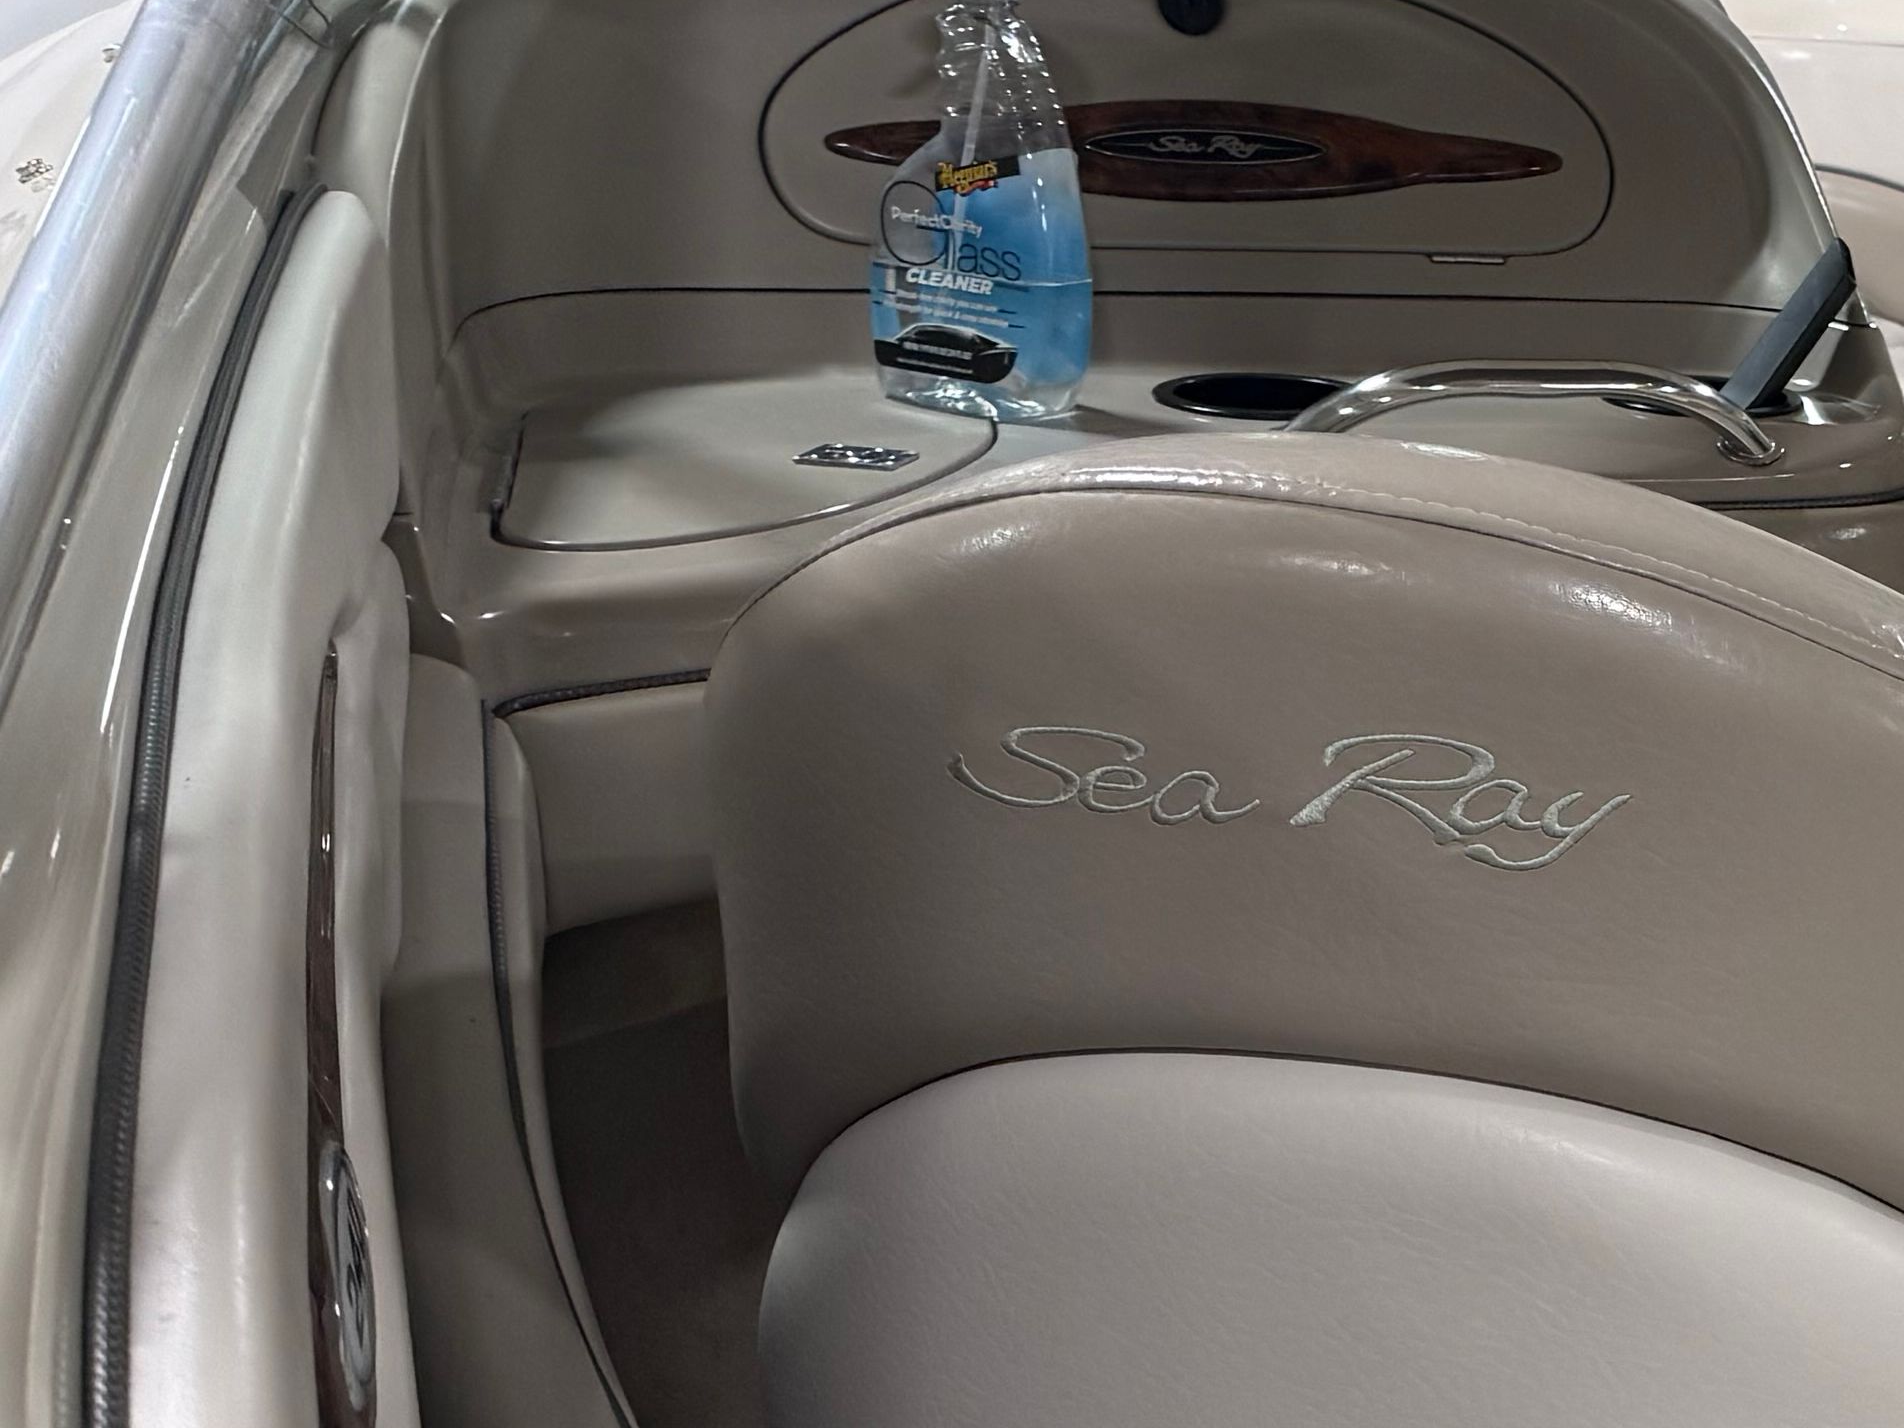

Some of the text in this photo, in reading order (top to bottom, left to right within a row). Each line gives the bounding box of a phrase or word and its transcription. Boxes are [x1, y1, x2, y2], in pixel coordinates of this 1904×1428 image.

[905, 267, 995, 296] CLEANER
[945, 725, 1633, 872] Sea Ray
